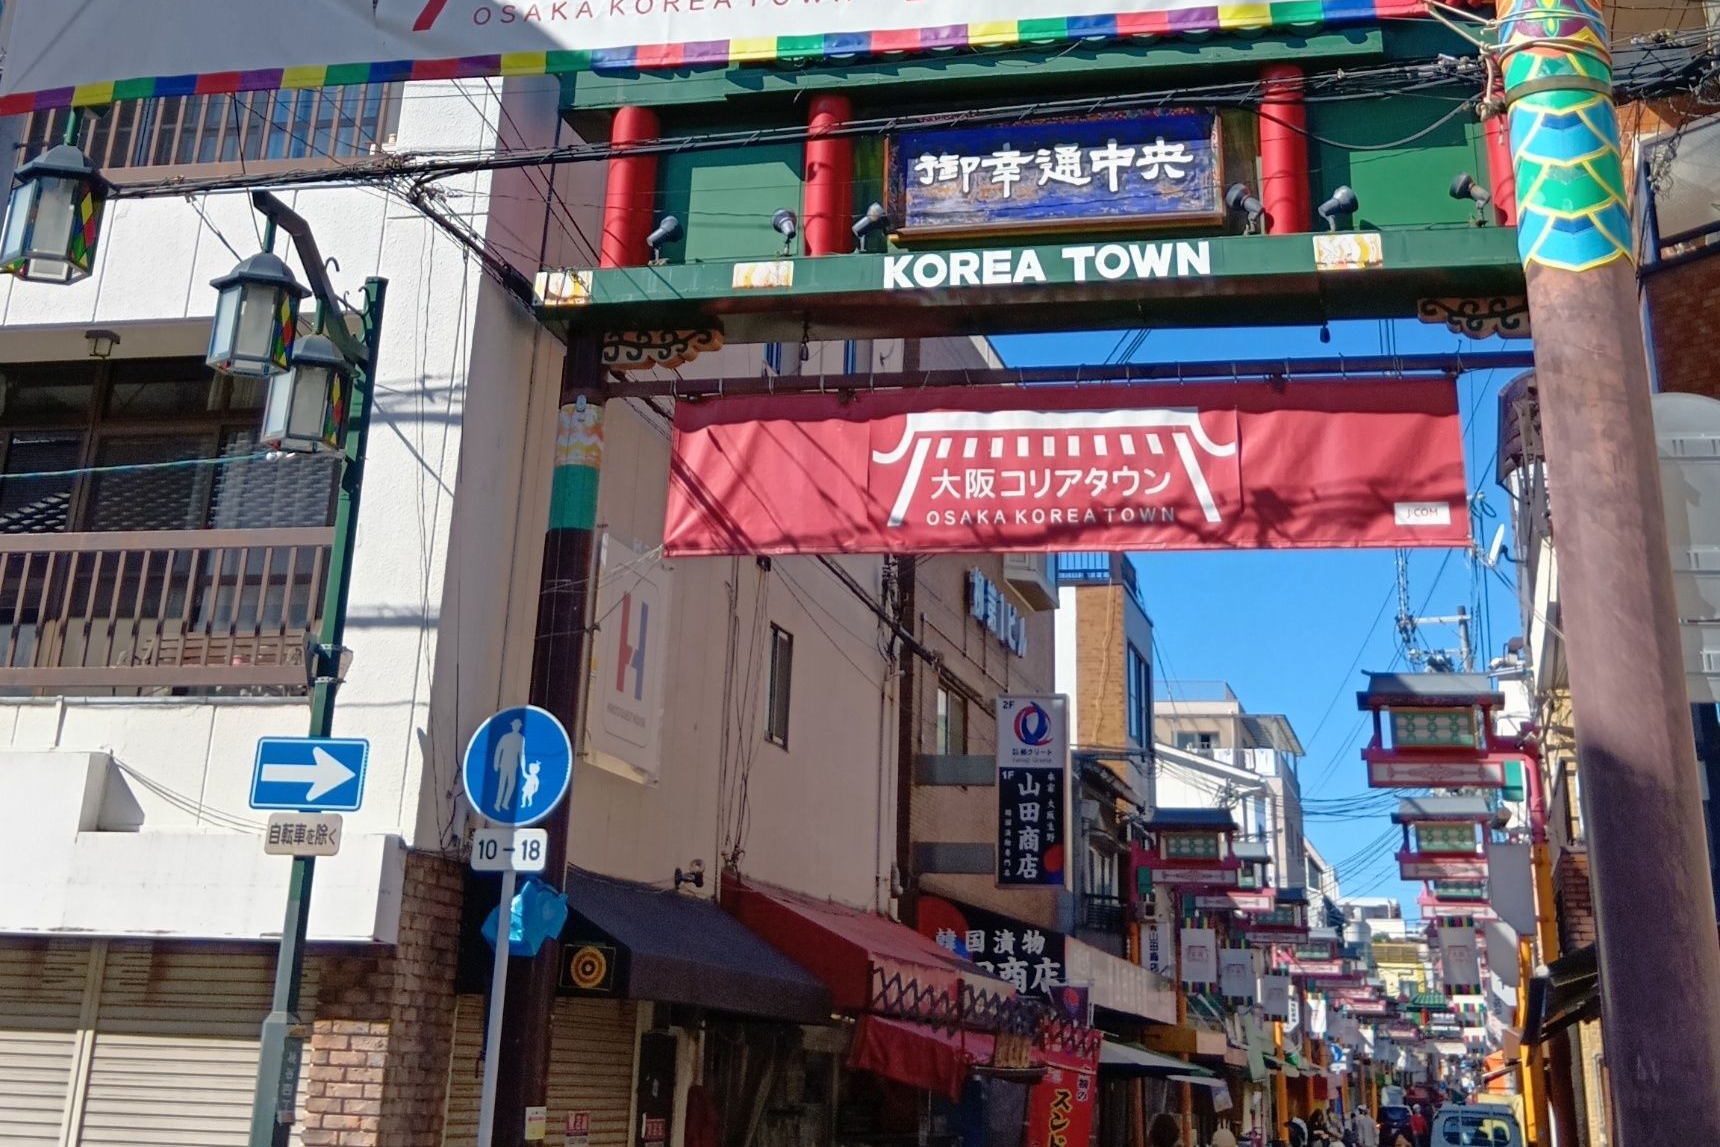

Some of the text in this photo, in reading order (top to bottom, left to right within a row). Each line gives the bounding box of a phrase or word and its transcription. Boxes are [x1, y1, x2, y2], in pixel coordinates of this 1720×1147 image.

[473, 0, 594, 25] OSAKA
[914, 136, 1194, 199] 御幸通中央
[883, 241, 1211, 290] KOREA TOWN
[930, 467, 1172, 500] 大阪コリアタウン
[926, 506, 1176, 526] OSAKA KOREA TOWN
[1002, 771, 1015, 780] 1F
[268, 824, 336, 846] 自転車を除く
[1016, 772, 1041, 880] 山田商店
[935, 927, 1046, 955] 韓国漬物
